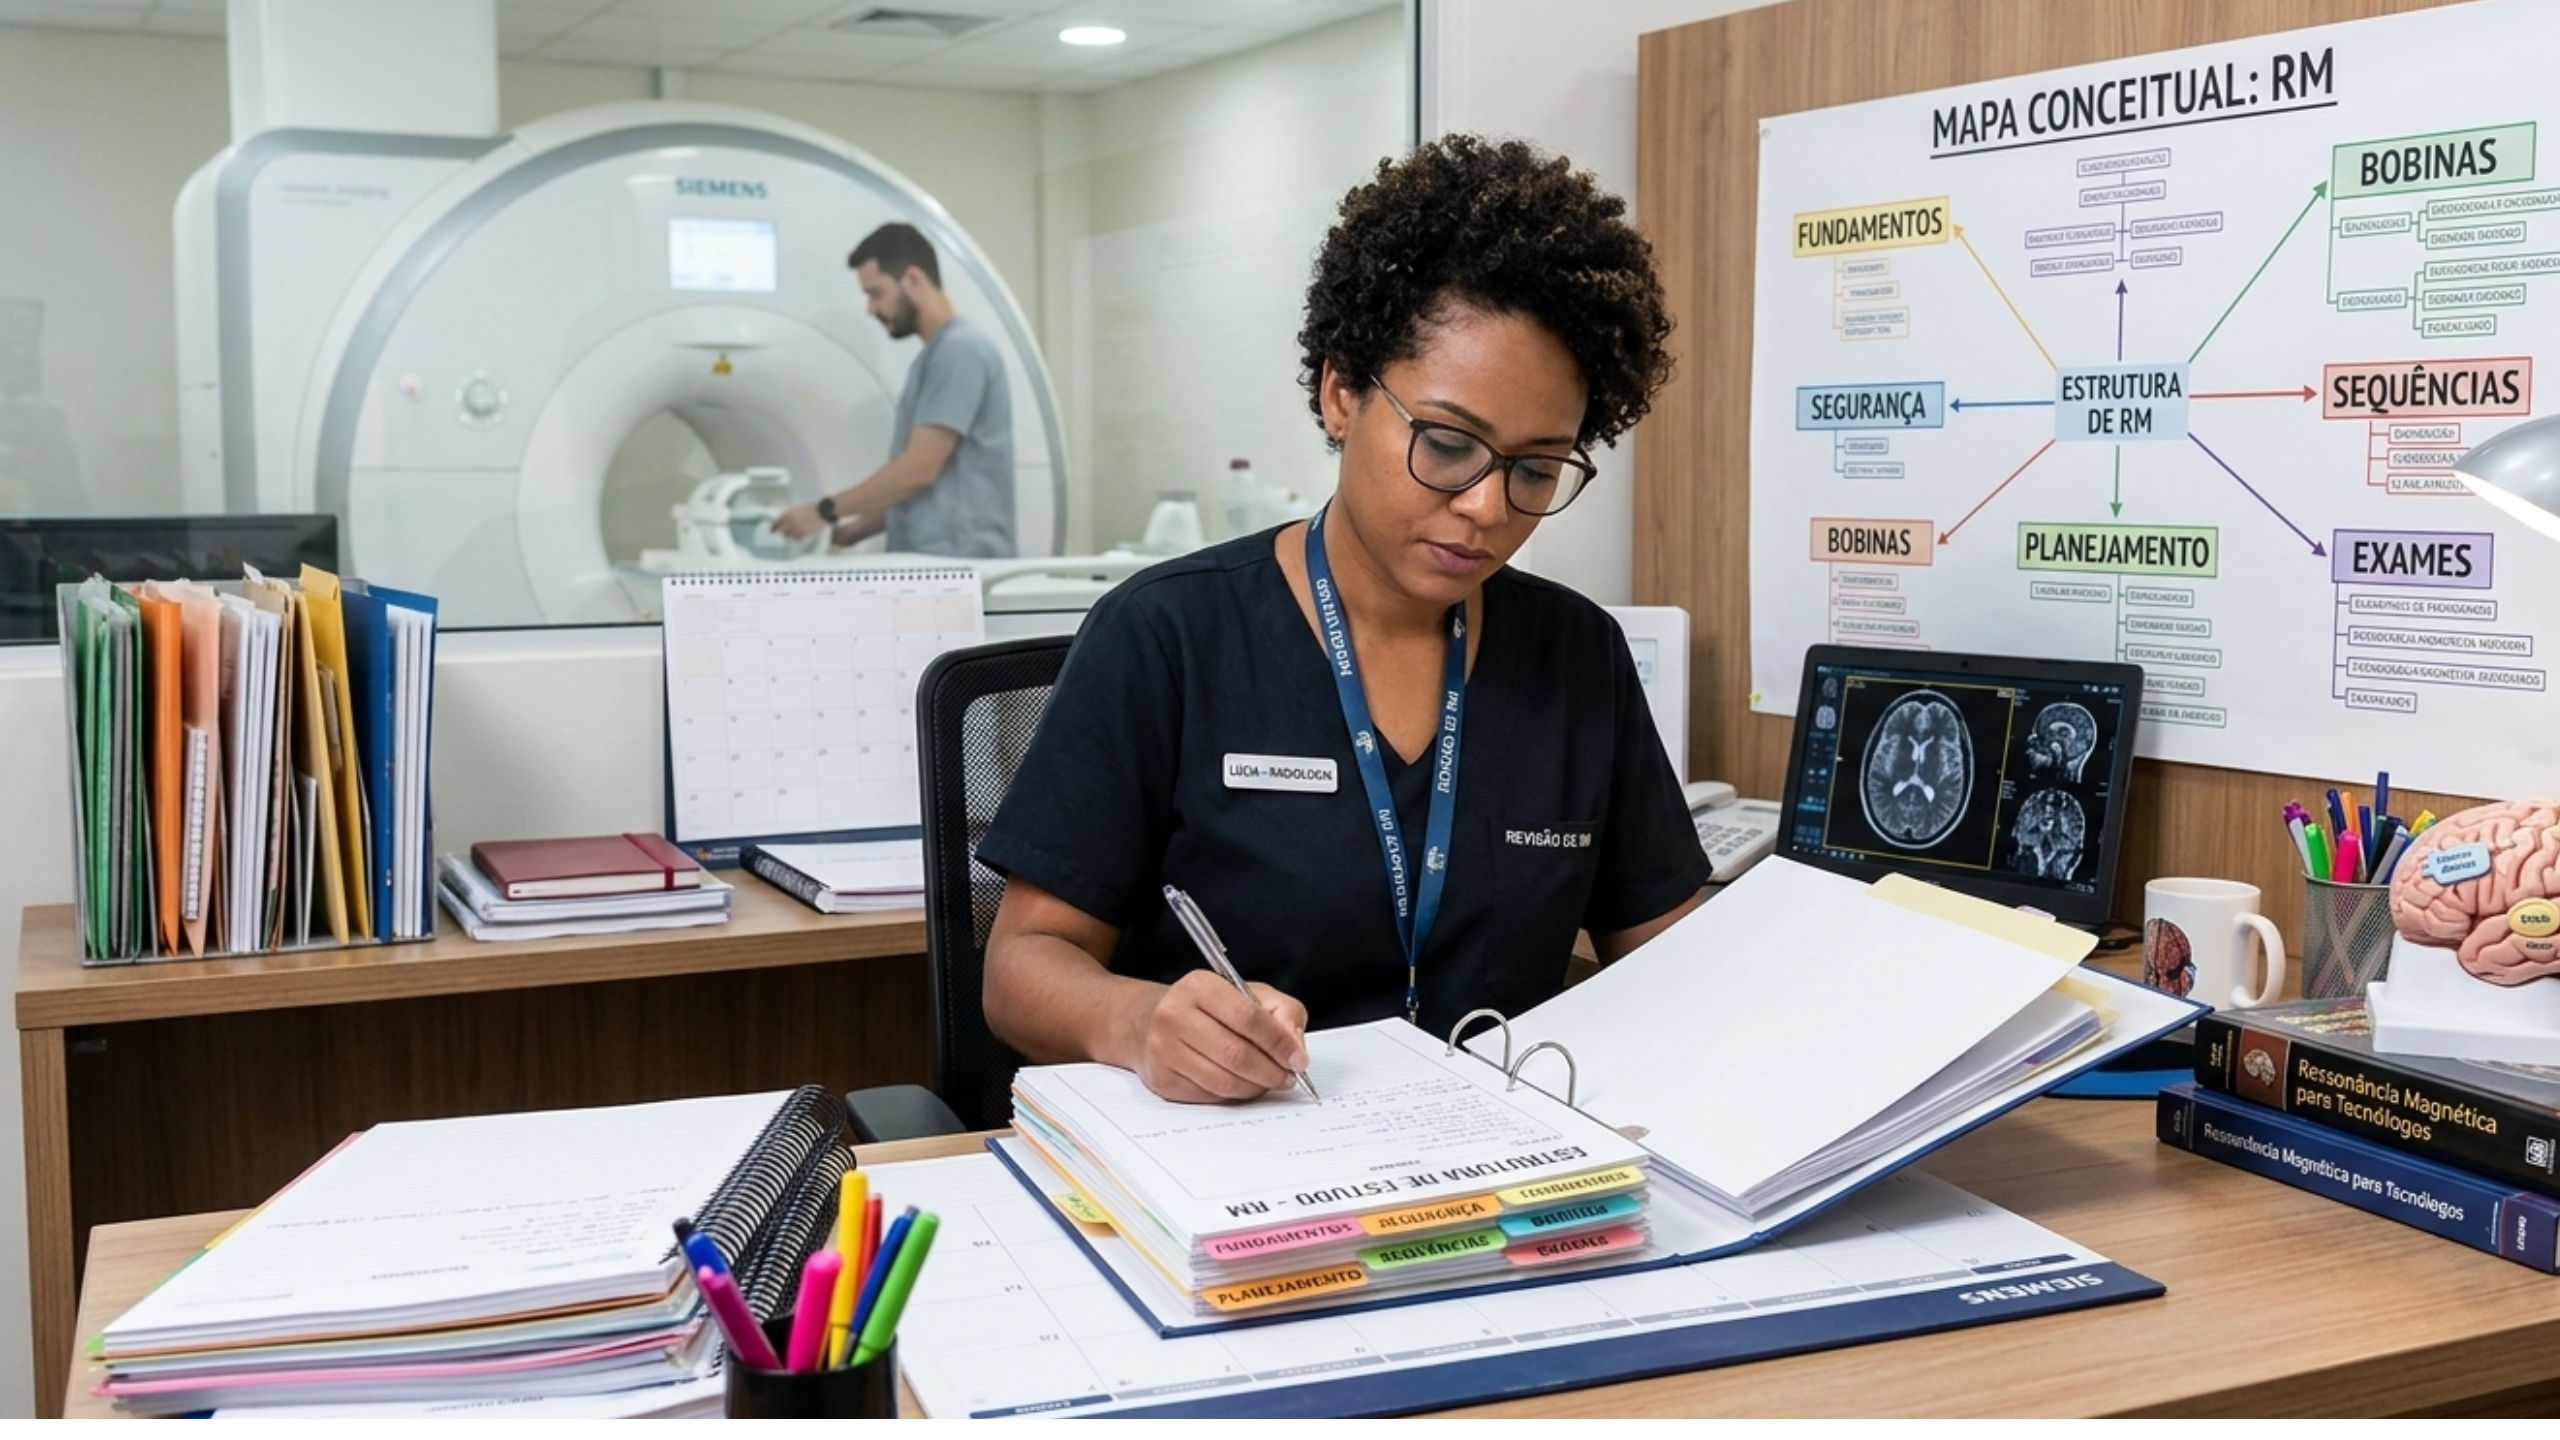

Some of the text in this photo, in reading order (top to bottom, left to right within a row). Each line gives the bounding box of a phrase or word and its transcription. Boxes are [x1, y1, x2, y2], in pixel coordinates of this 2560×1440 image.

[1933, 47, 2333, 148] MAPA CONCEITUAL: RM
[2361, 138, 2497, 187] BOBINAS
[675, 178, 768, 199] SIEMENS
[1799, 207, 1942, 248] FUNDAMENTOS
[2062, 372, 2182, 402] ESTRUTURA
[2333, 364, 2520, 415] SEQUÊNCIAS
[1811, 391, 1926, 425] SEGURANÇA
[2088, 407, 2152, 435] DE RM
[1828, 527, 1911, 557] BOBINAS
[2025, 532, 2210, 568] PLANEJAMENTO
[2353, 541, 2472, 578] EXAMES
[2404, 1088, 2497, 1135] Magnética
[1400, 1173, 1440, 1189] DE
[1442, 1146, 1588, 1182] ESTRUTURA
[1295, 1179, 1399, 1206] ESTUDO
[1957, 1273, 2104, 1305] SIEMENS
